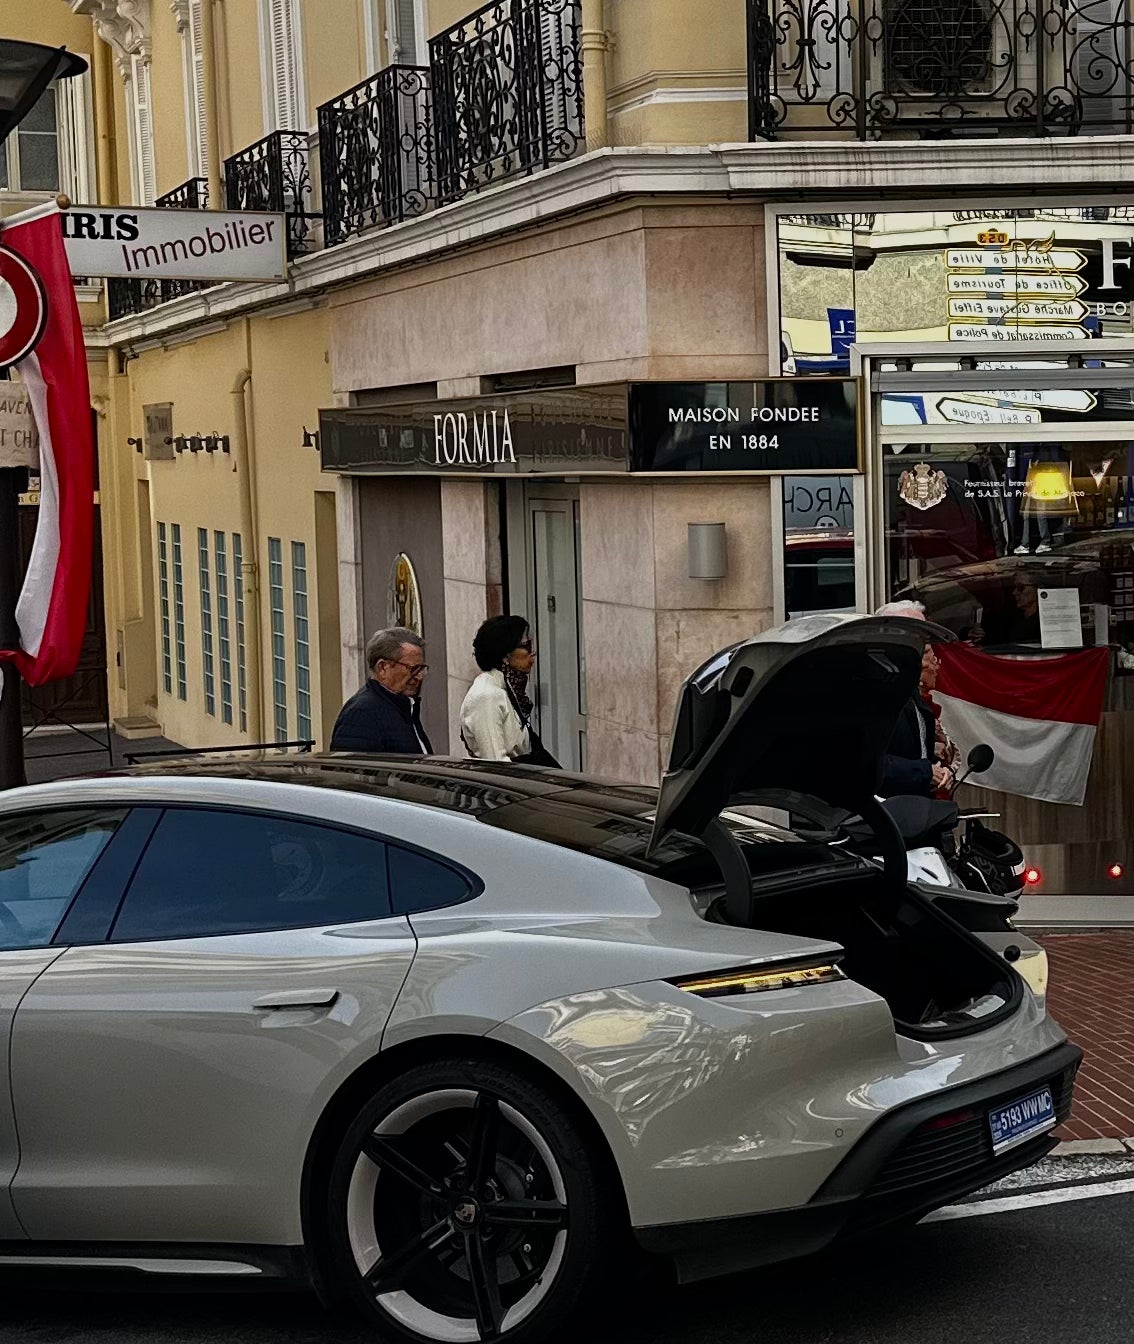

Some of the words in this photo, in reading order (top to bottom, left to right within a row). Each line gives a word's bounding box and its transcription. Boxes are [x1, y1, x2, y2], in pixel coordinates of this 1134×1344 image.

[62, 213, 139, 241] IRIS
[122, 220, 275, 272] Immobilier
[668, 407, 740, 423] MAISON
[751, 407, 820, 422] FONDEE
[433, 408, 517, 464] FORMIA
[710, 435, 731, 450] EN
[741, 435, 779, 450] 1884
[1000, 1105, 1022, 1131] 5193
